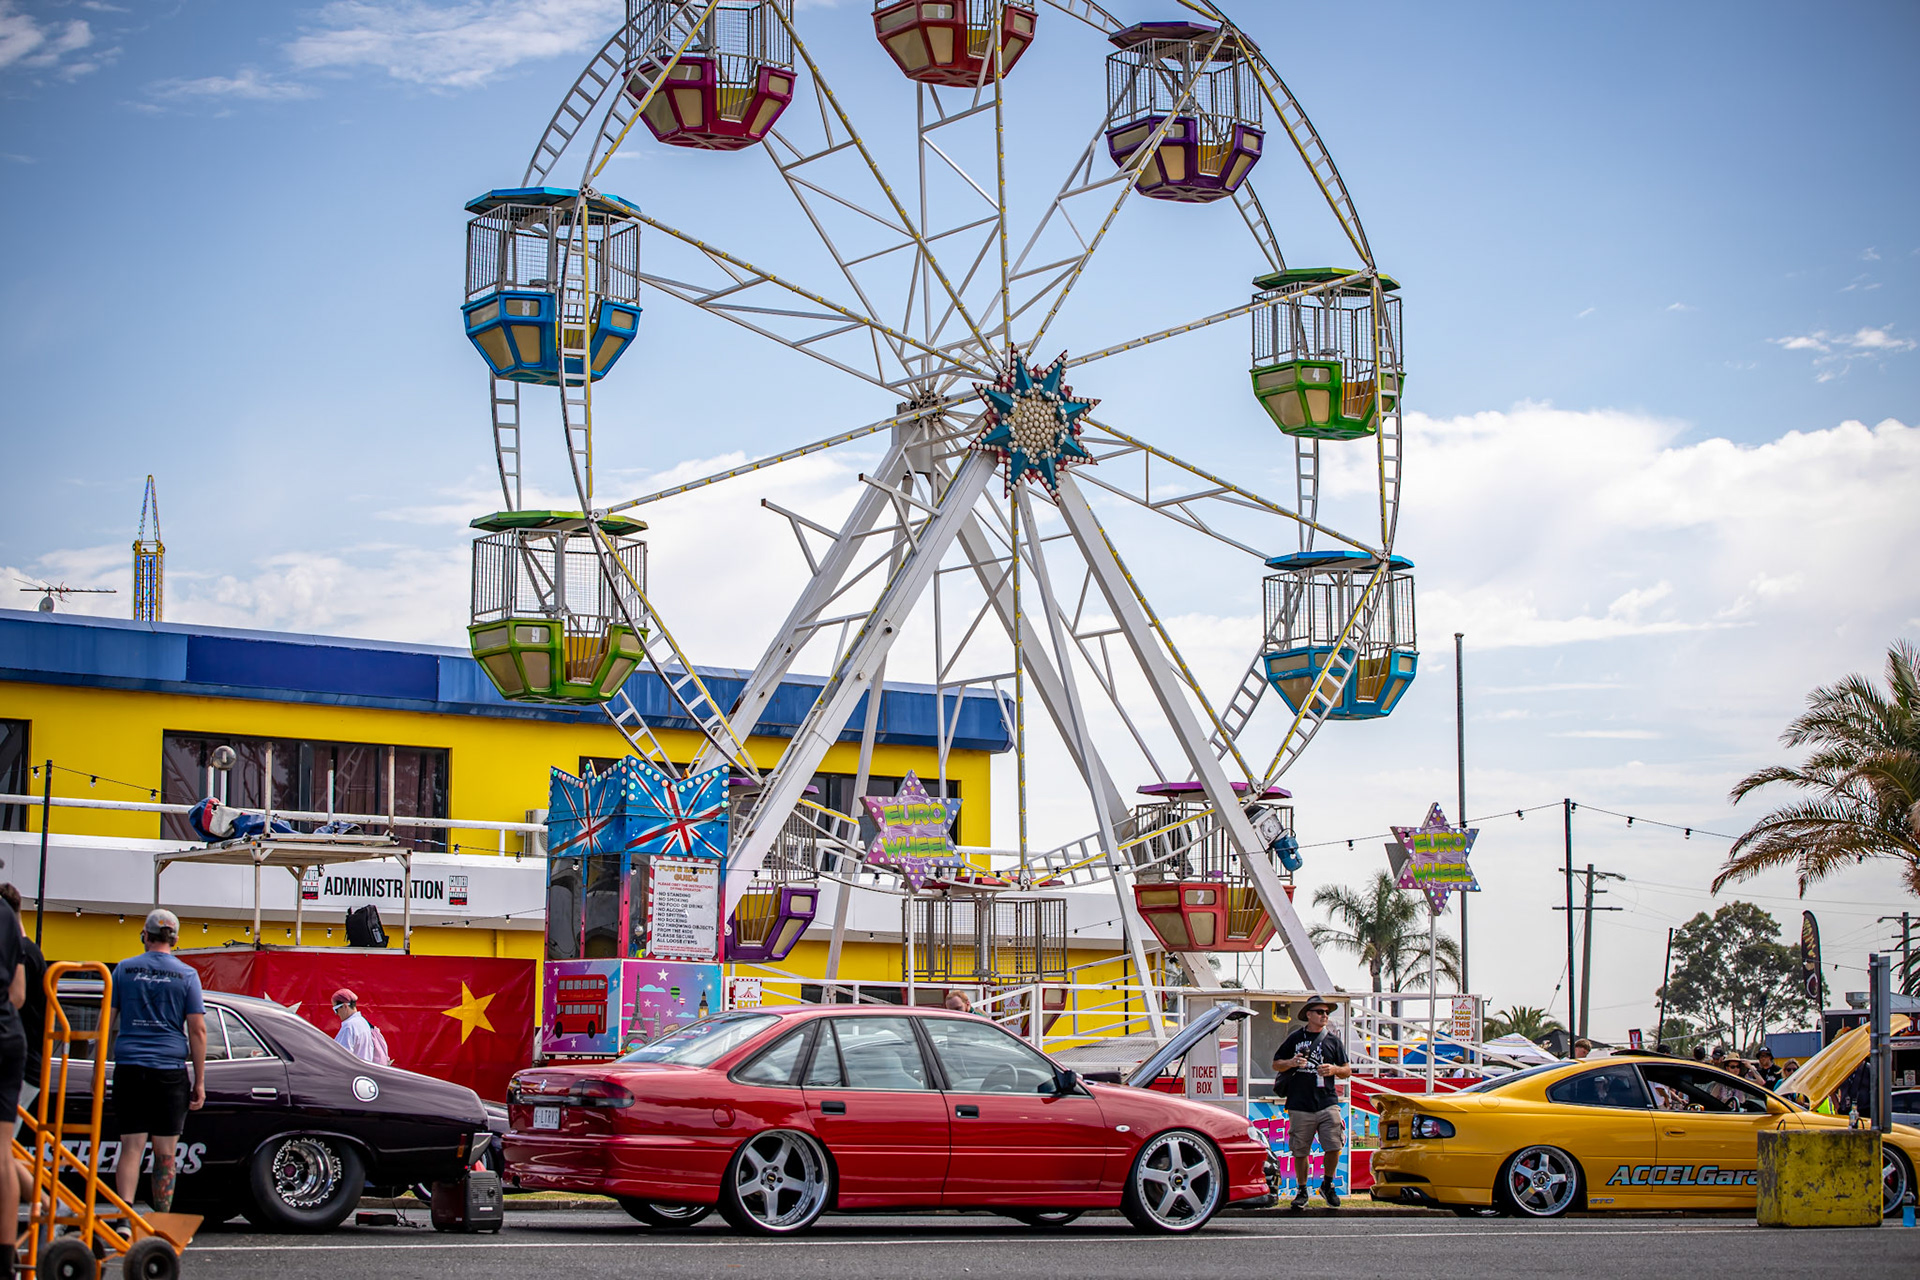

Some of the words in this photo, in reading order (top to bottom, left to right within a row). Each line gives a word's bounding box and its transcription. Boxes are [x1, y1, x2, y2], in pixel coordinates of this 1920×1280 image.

[522, 300, 530, 316] 8
[1312, 367, 1320, 382] 4
[531, 626, 540, 643] 9
[883, 802, 947, 826] EURO
[881, 836, 954, 858] WHEEL
[1413, 832, 1467, 854] EURO
[684, 866, 713, 875] SAETY
[1410, 862, 1473, 883] WHEEL
[1196, 890, 1205, 905] 2
[737, 1000, 758, 1008] EXIT
[1191, 1065, 1217, 1079] TICKET
[1196, 1081, 1212, 1094] BOX
